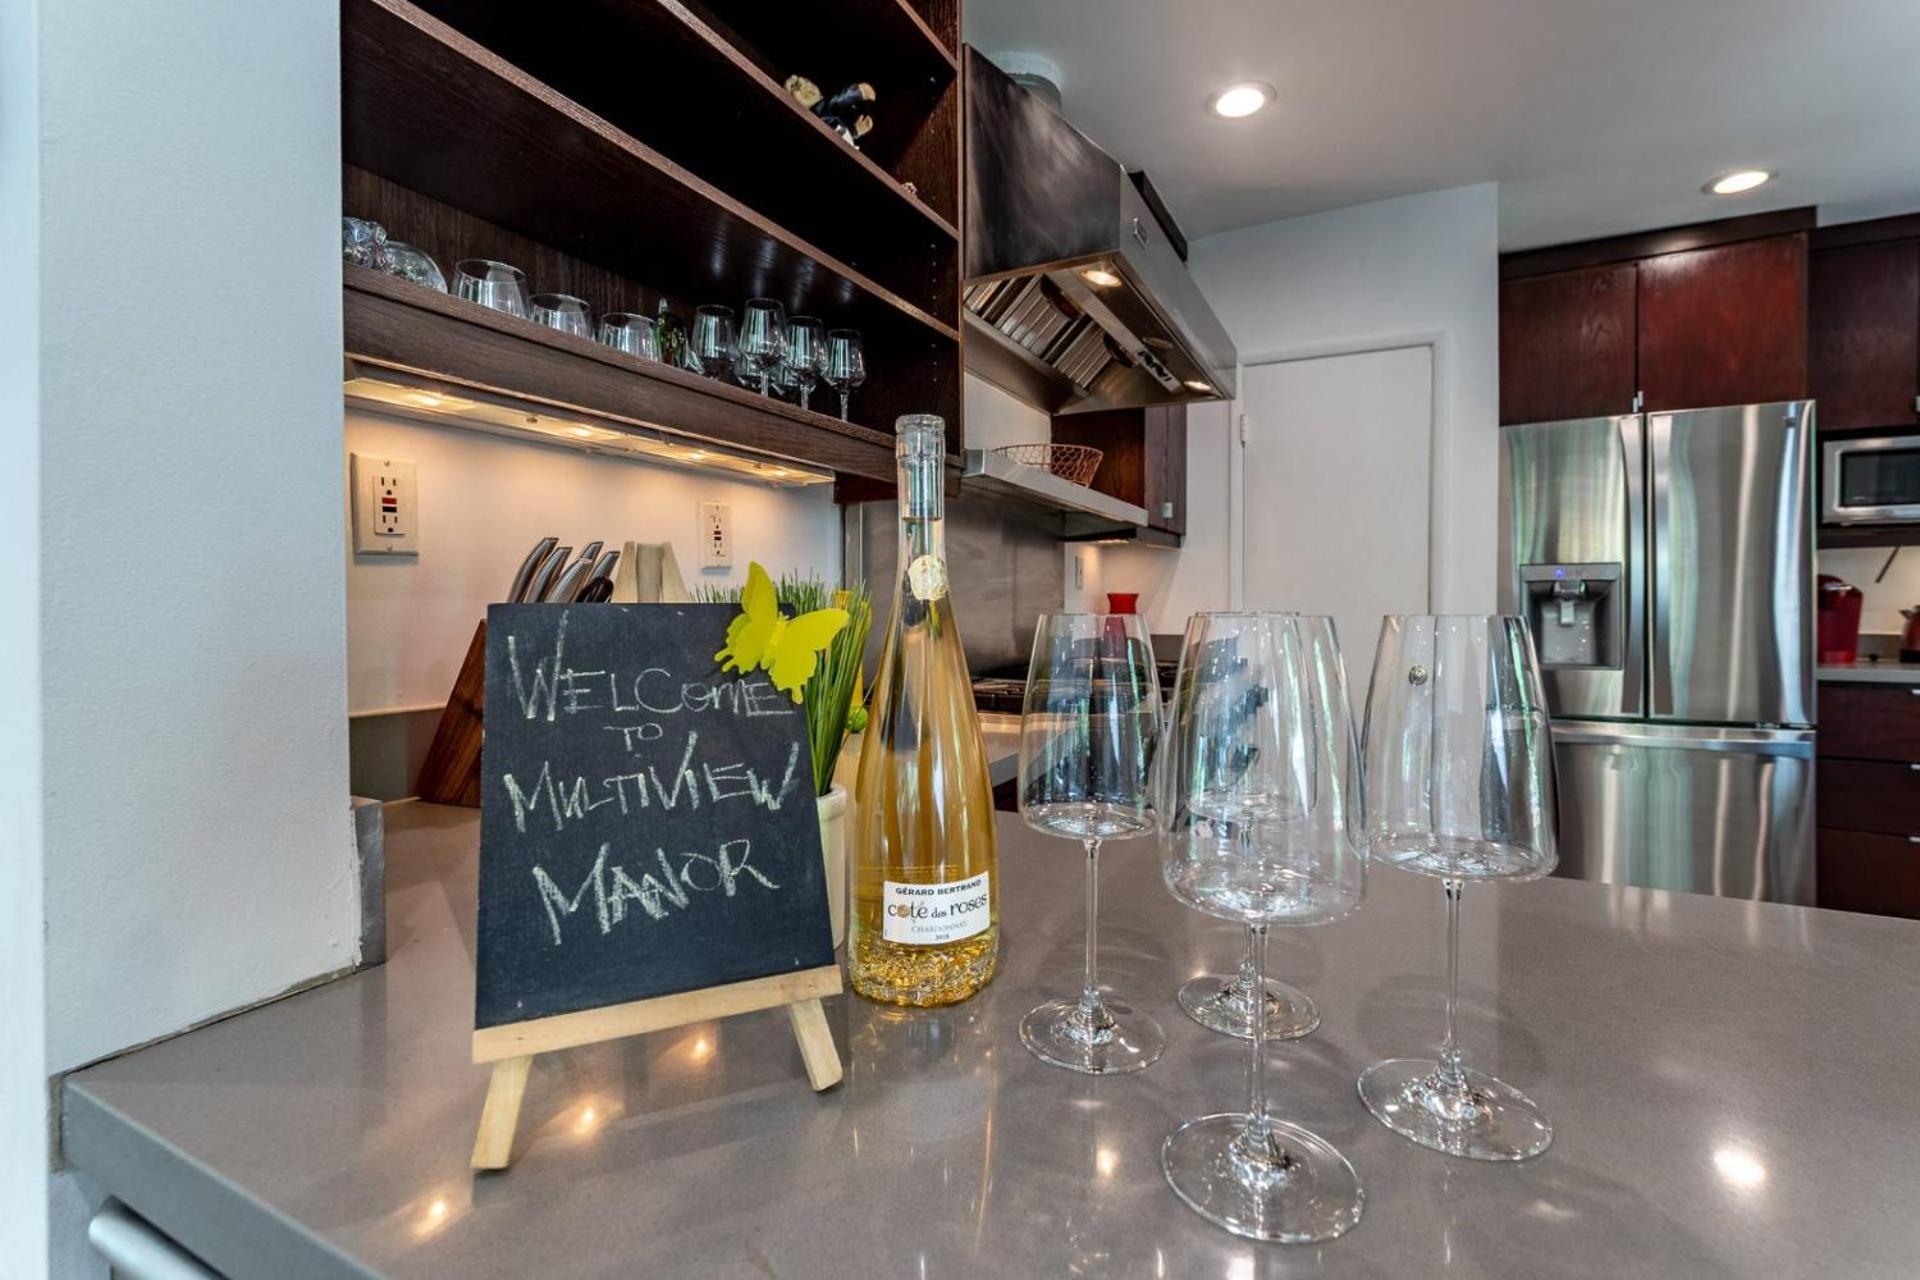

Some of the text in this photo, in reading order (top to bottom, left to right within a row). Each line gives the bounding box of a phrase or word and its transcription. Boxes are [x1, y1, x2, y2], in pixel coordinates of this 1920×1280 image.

[507, 609, 794, 721] WELCOME
[603, 722, 663, 751] TO
[503, 730, 799, 832] MULTIVIEW
[532, 839, 780, 945] MANOR
[896, 880, 982, 896] GÉRARD BERTRAND
[950, 893, 987, 916] roses
